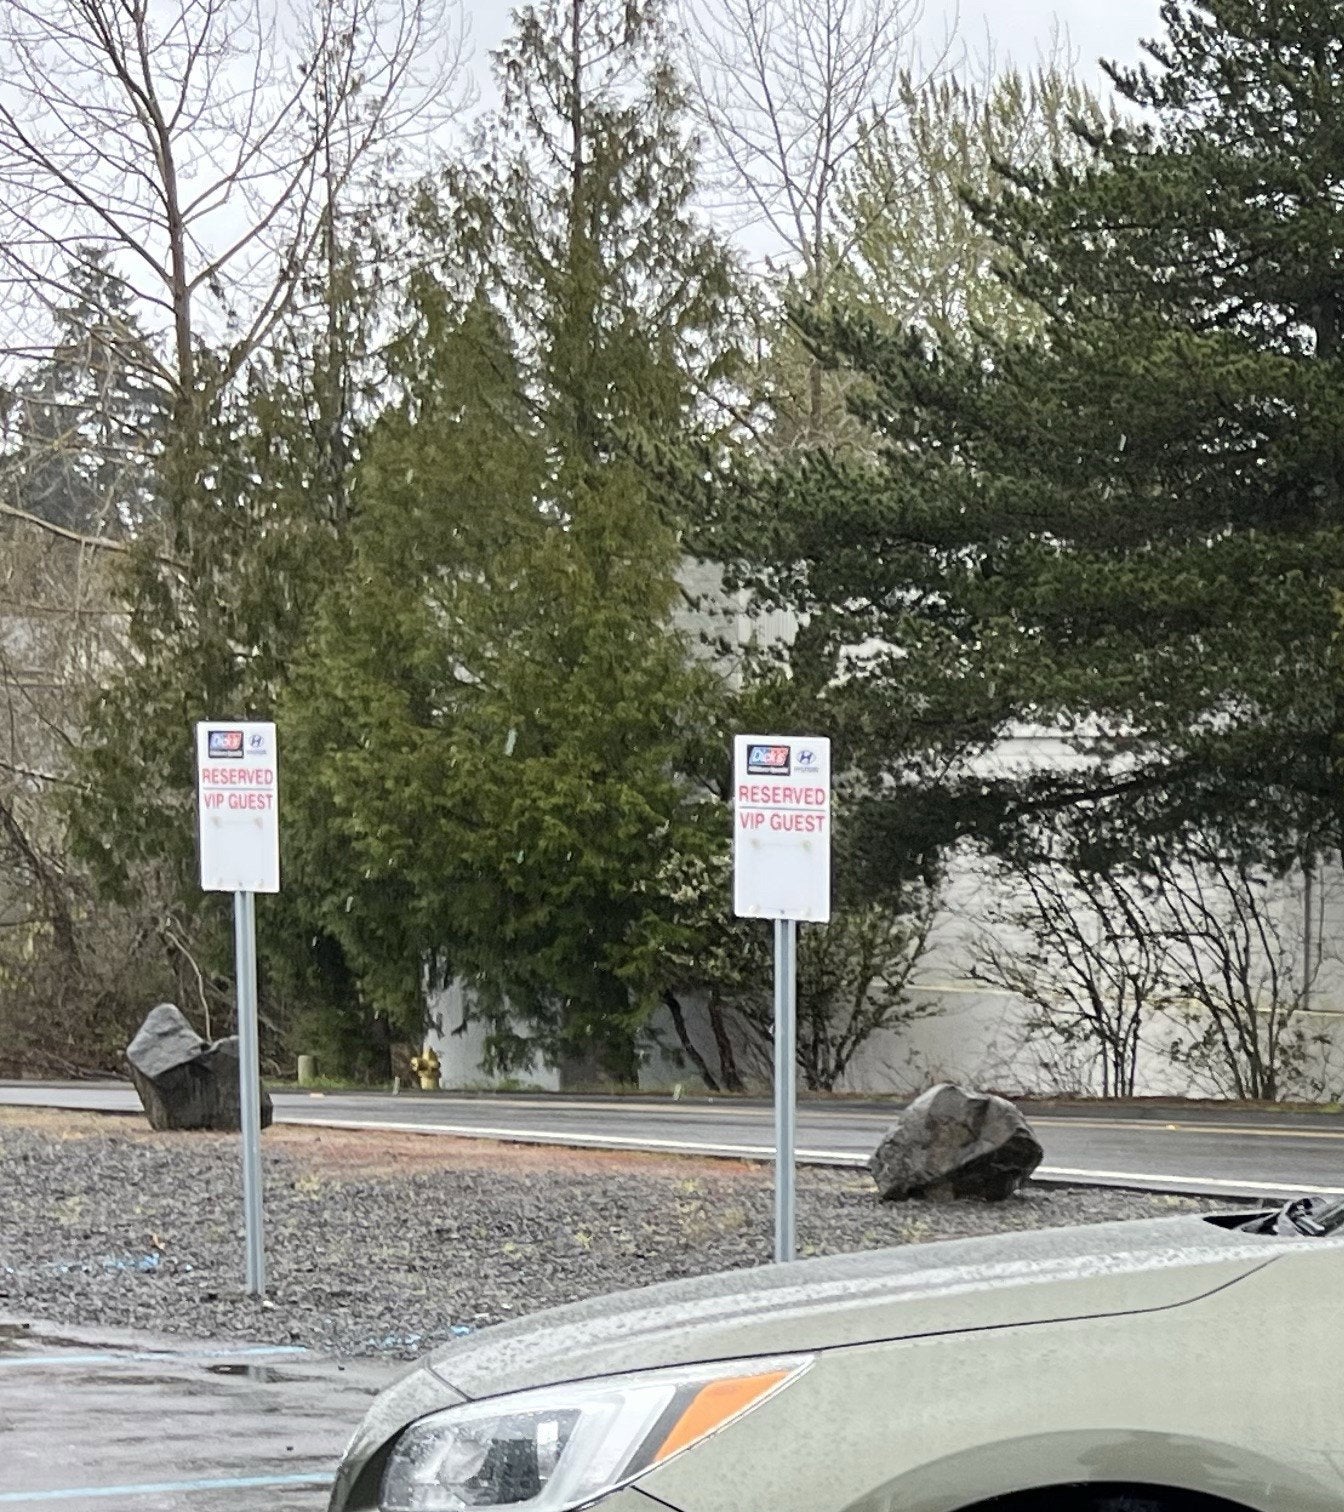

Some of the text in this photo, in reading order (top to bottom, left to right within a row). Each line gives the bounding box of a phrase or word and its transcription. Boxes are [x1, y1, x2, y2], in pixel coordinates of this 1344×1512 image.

[202, 768, 274, 785] RESERVED
[203, 793, 273, 810] VIP GUEST
[739, 785, 825, 805] RESERVED
[740, 812, 825, 832] VIP GUEST
